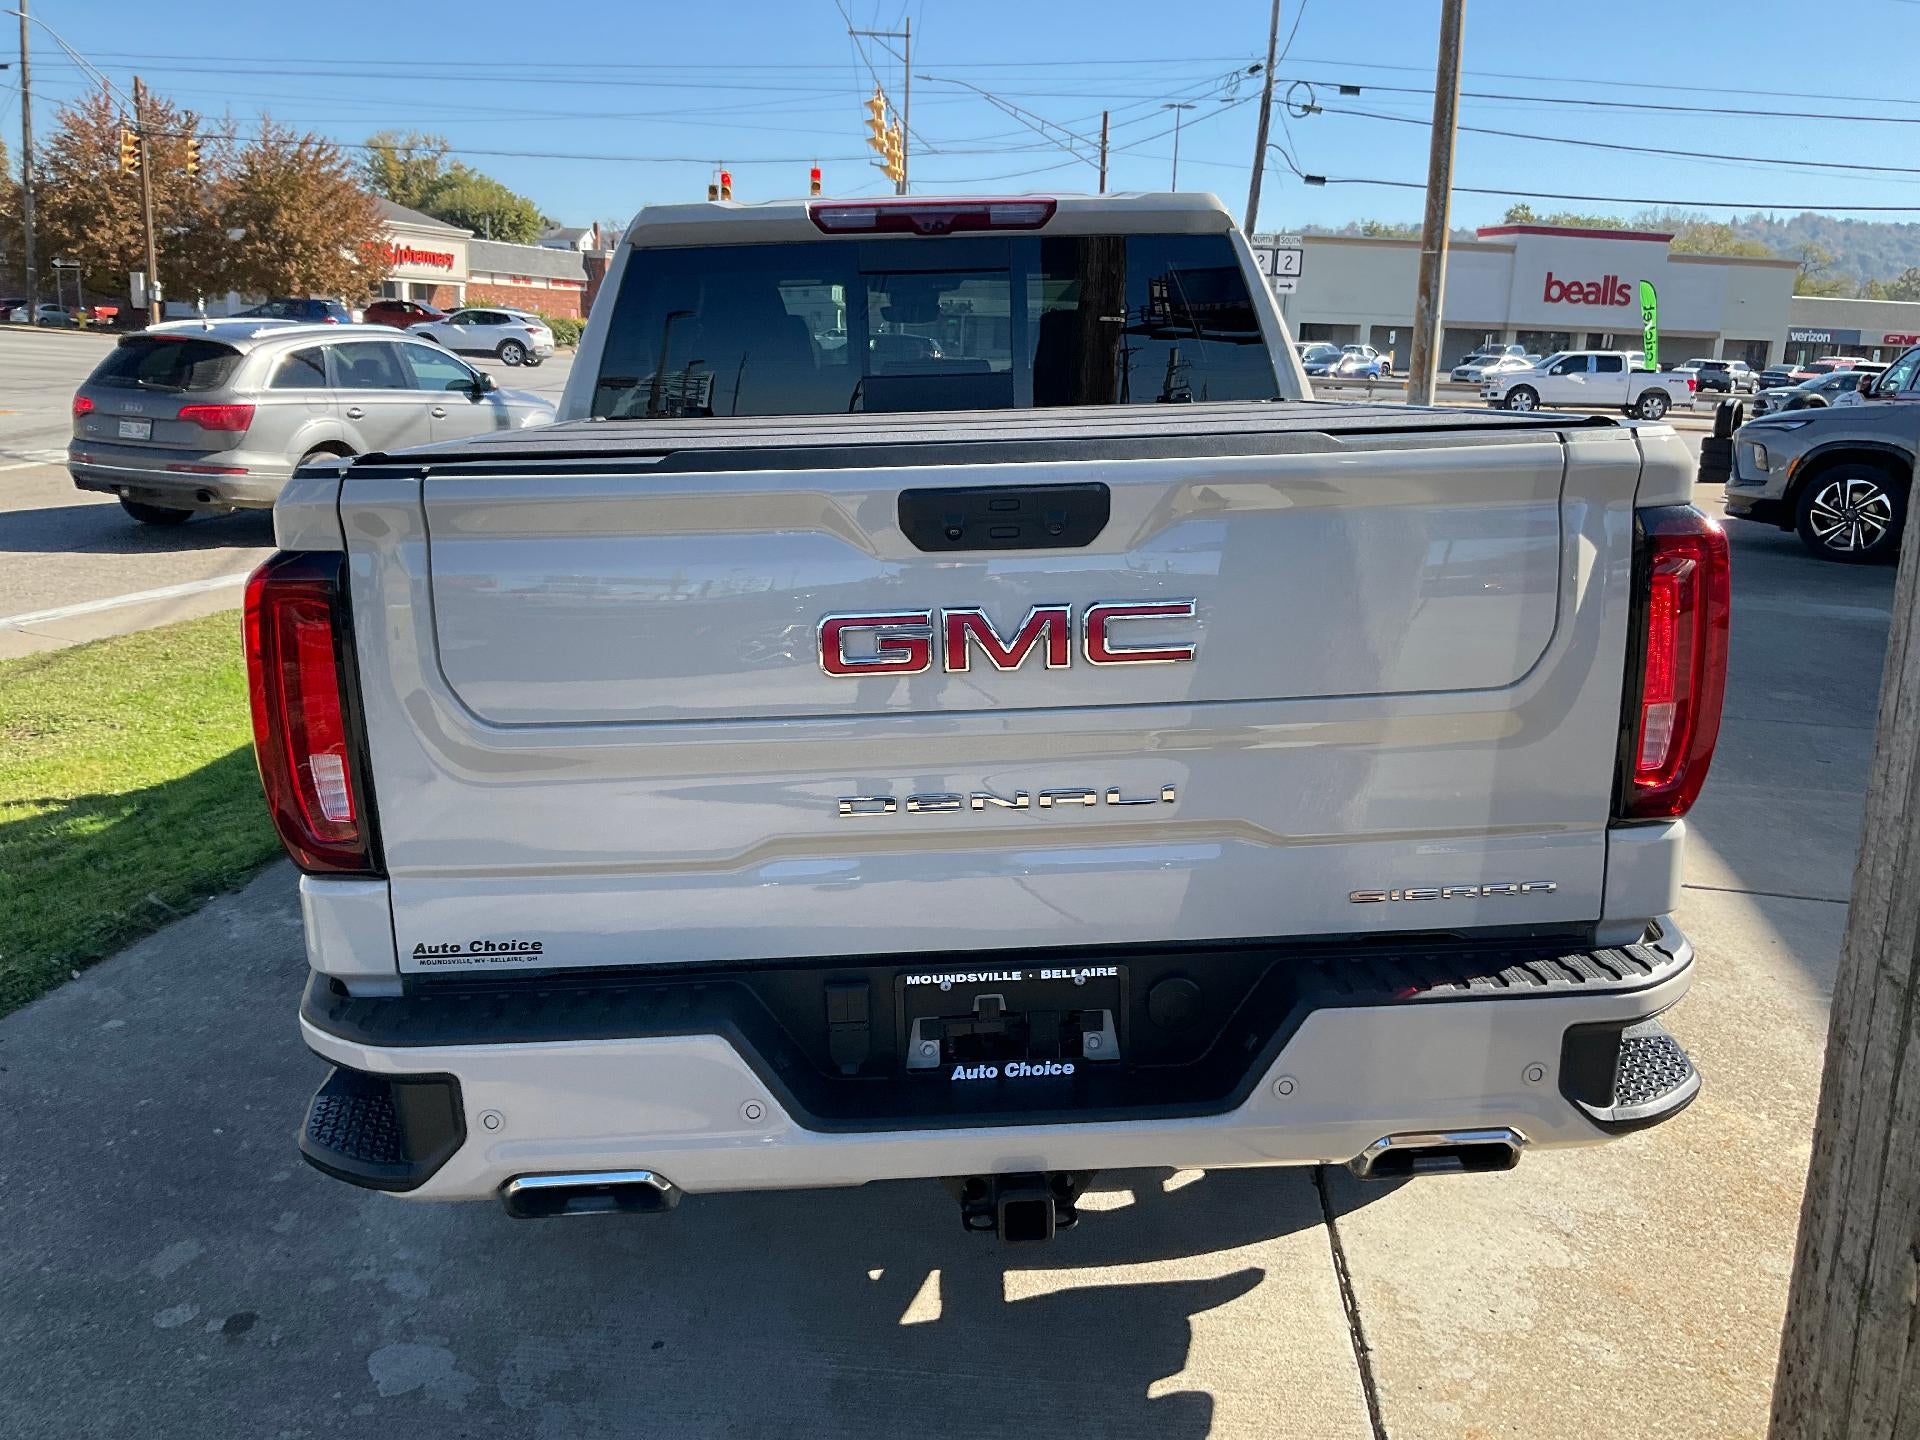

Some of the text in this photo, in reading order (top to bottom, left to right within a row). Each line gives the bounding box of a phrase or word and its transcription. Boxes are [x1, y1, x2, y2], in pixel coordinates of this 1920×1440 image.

[1253, 235, 1272, 244] NORTH
[1280, 236, 1300, 244] SOUTH
[1284, 255, 1293, 270] 2
[1543, 271, 1632, 306] bealls
[1790, 330, 1831, 342] verizon
[817, 598, 1198, 677] GMC
[838, 783, 1176, 818] DENALI
[1350, 881, 1558, 903] SIERRA
[412, 939, 543, 954] Auto Choice
[906, 966, 1118, 985] MOUNDSVILLE BELLAIRE
[951, 1060, 1075, 1081] Auto Choice
